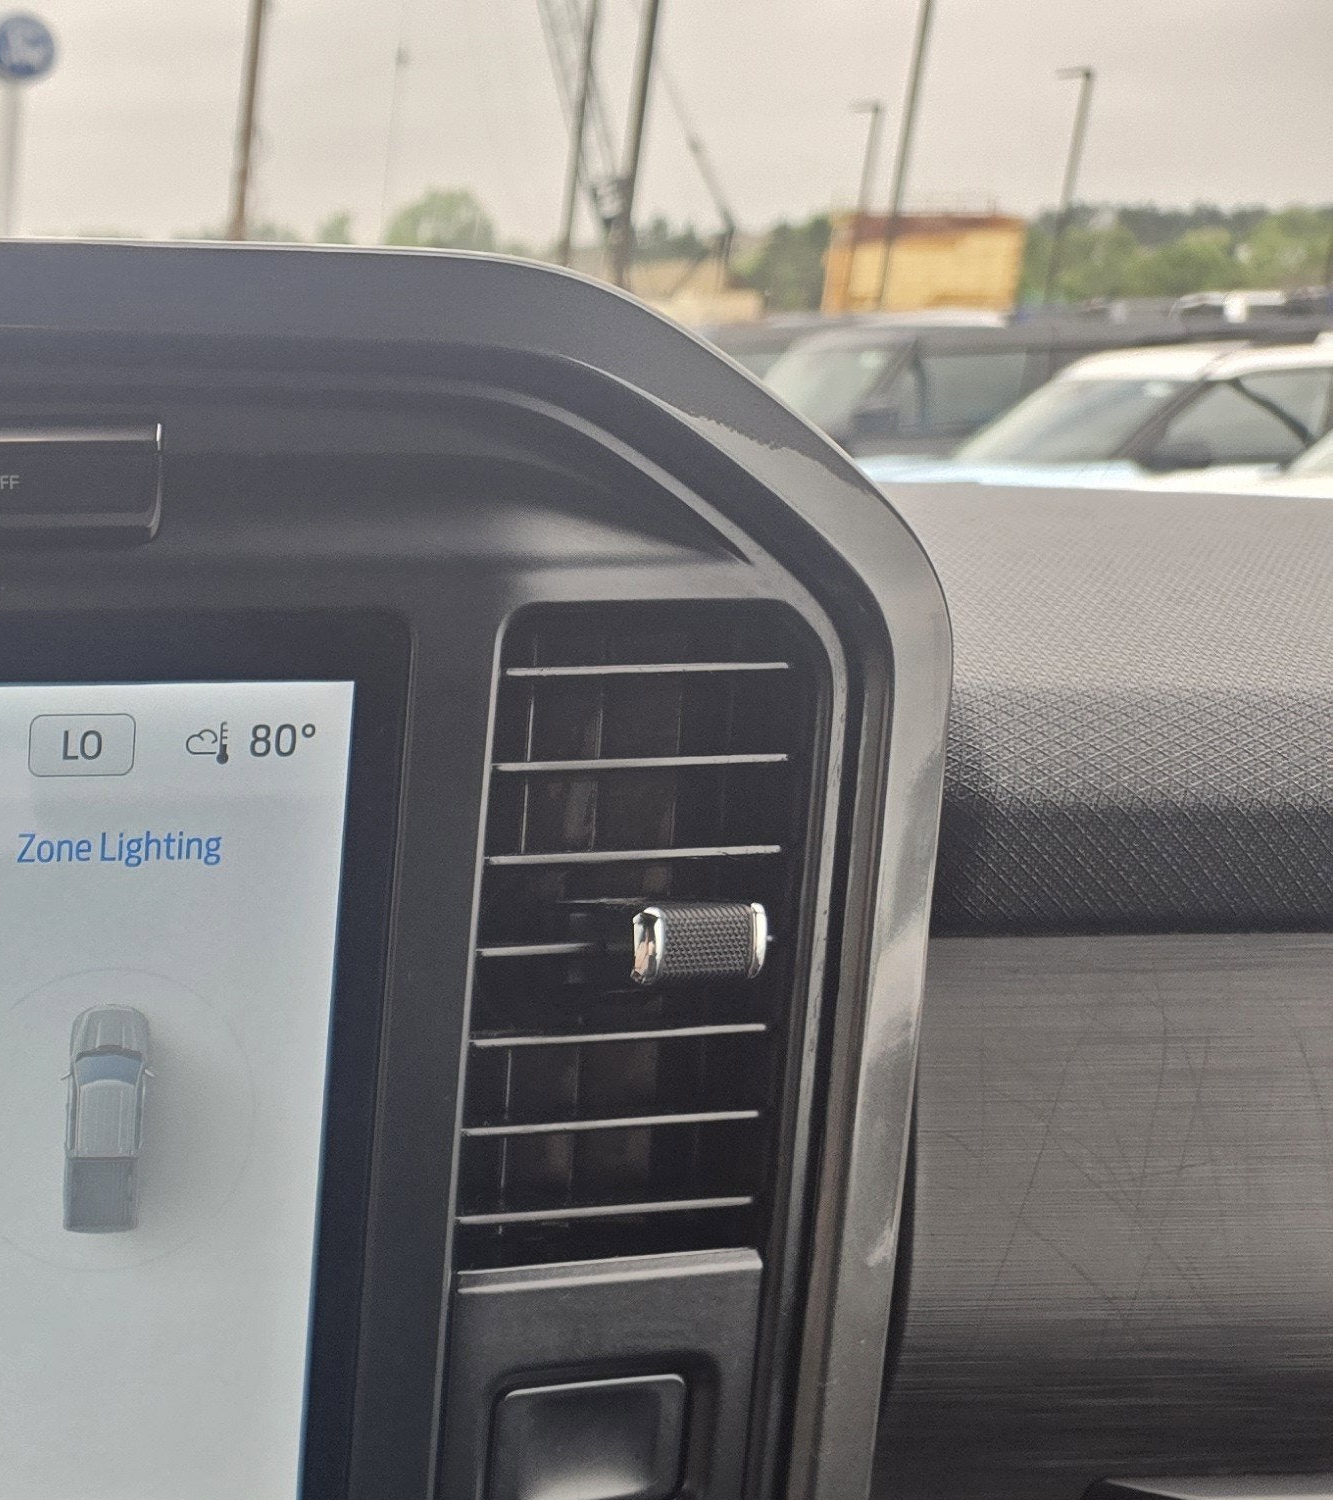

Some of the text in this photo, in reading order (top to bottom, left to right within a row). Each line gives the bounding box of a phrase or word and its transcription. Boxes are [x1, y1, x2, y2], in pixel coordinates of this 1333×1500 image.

[62, 731, 103, 762] LO
[249, 724, 316, 759] 80°
[17, 831, 222, 869] Zone Lighting
